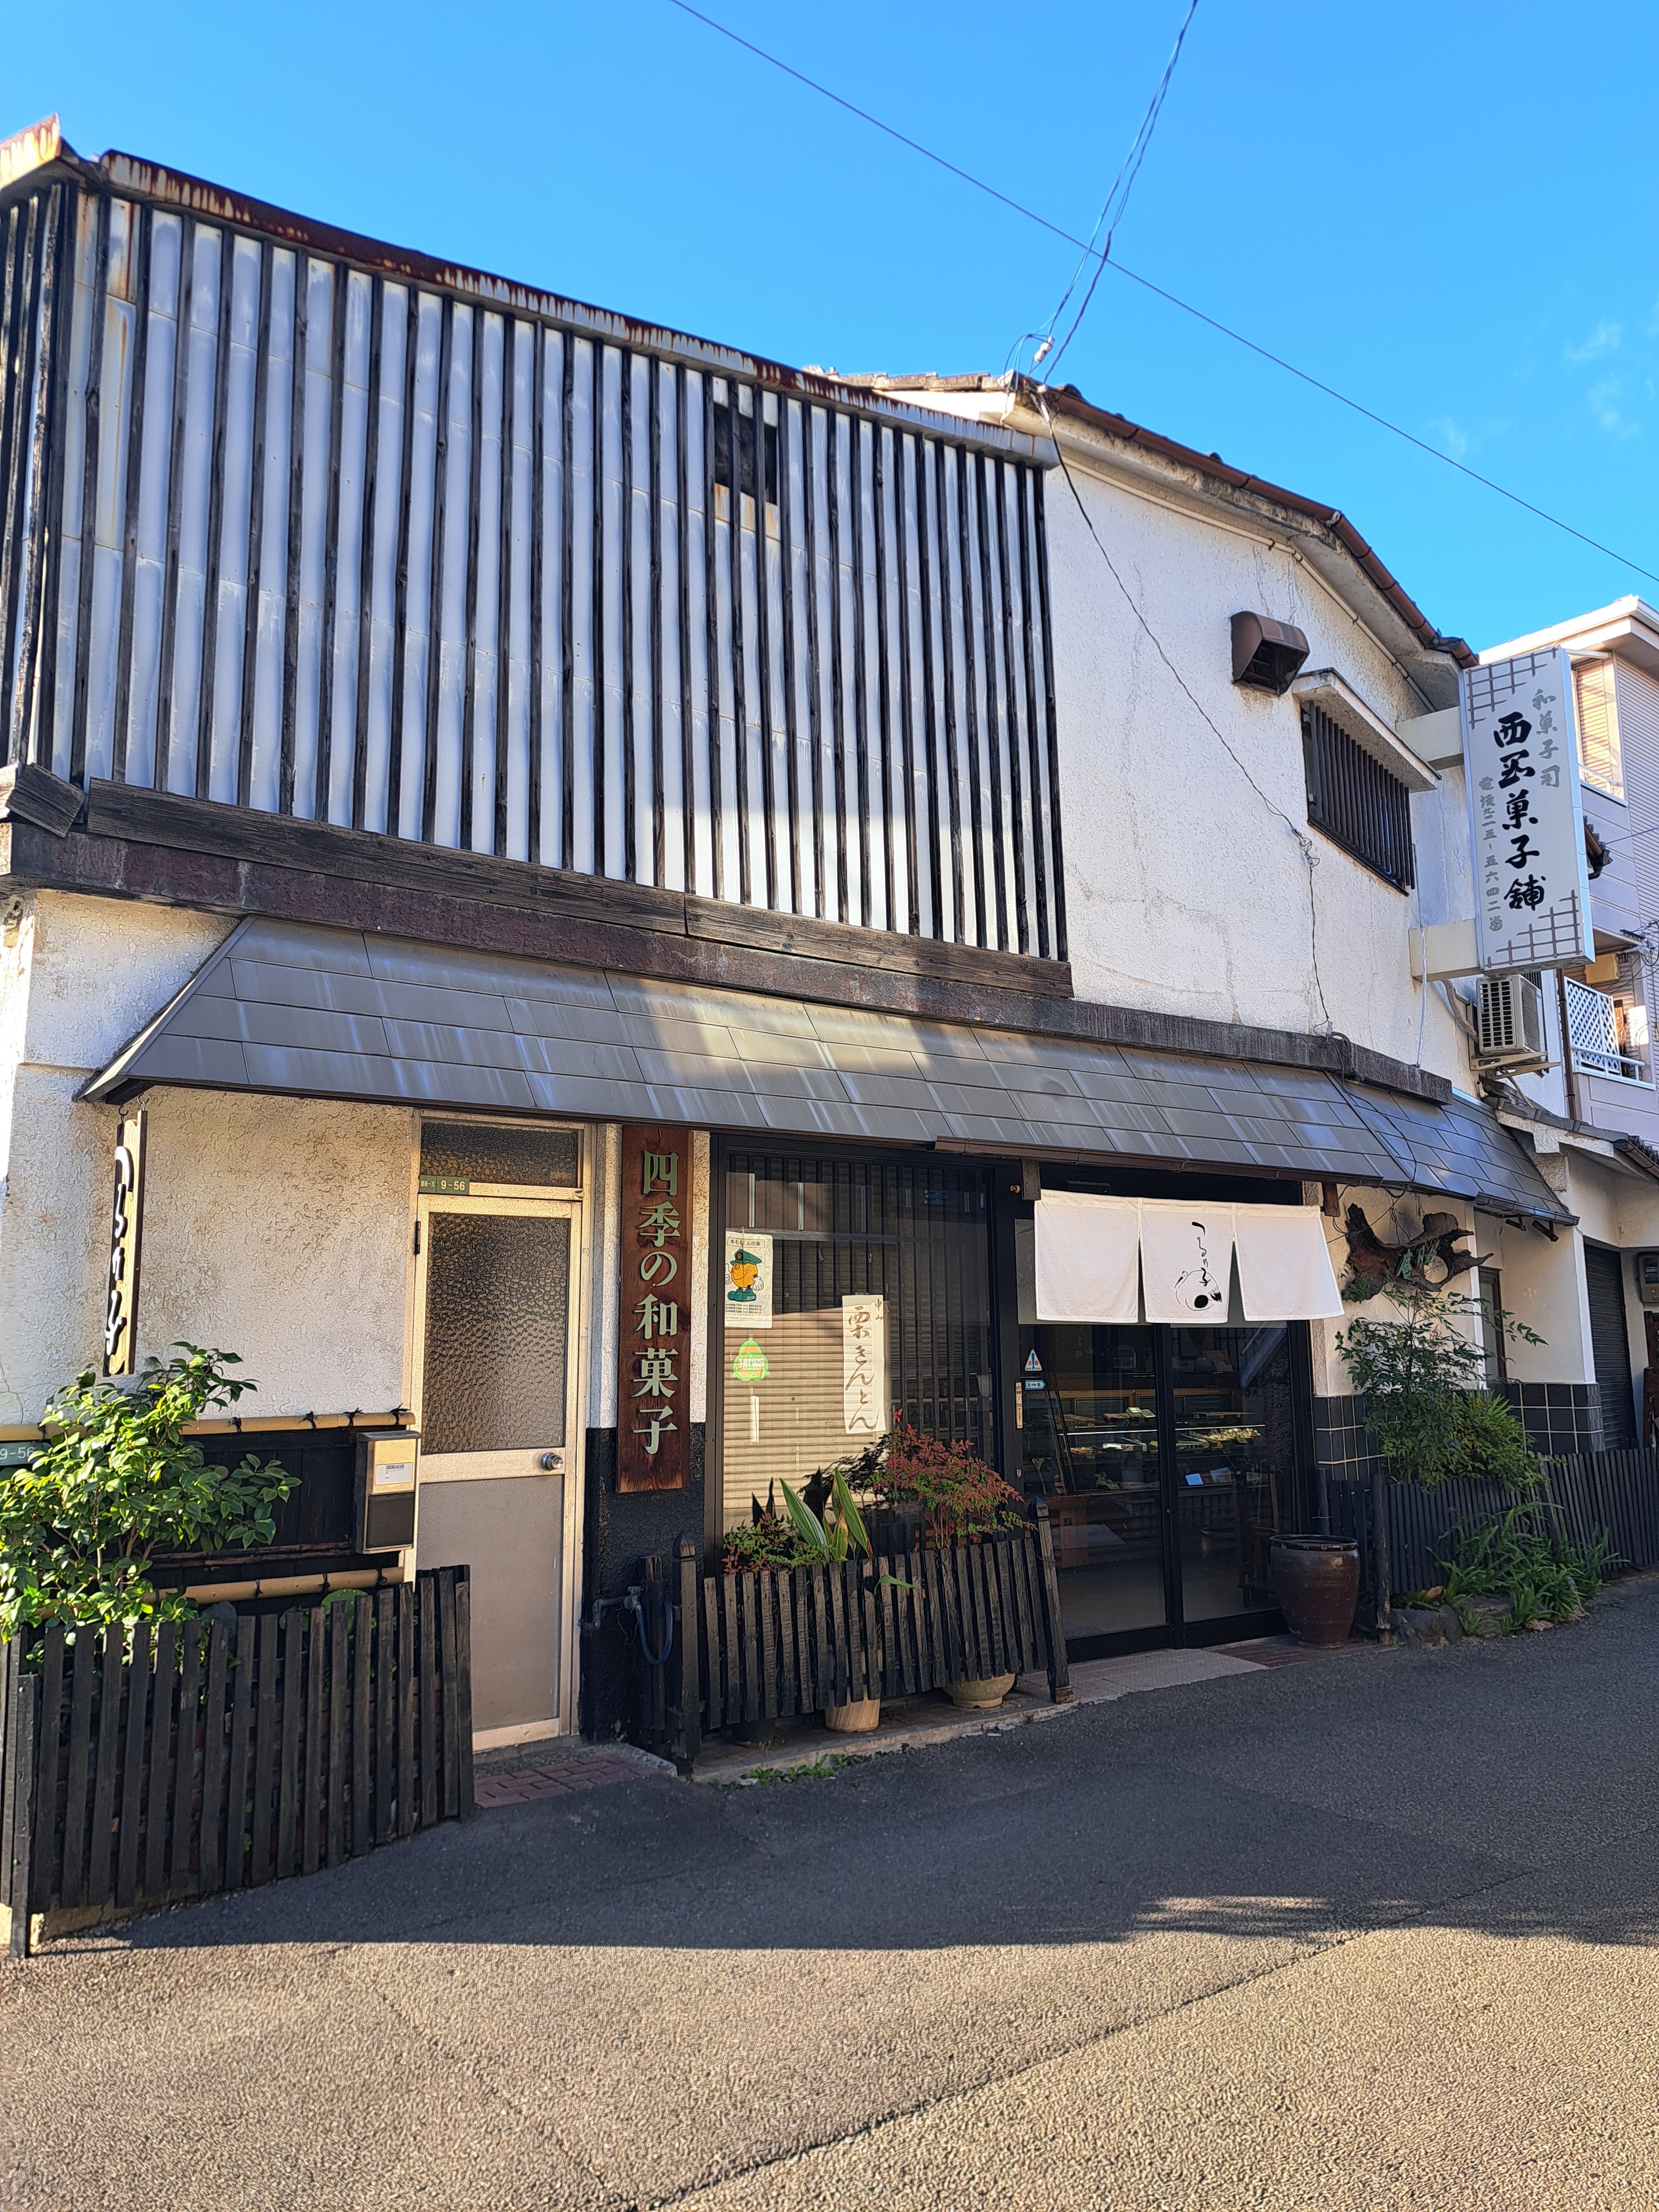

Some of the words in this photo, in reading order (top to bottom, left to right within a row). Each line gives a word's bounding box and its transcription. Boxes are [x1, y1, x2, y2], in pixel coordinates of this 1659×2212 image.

[1532, 688, 1561, 789] 和菓子司
[441, 1180, 465, 1191] 9-56
[630, 1150, 681, 1455] 四季の和菓子
[845, 1305, 880, 1431] 栗きんとん
